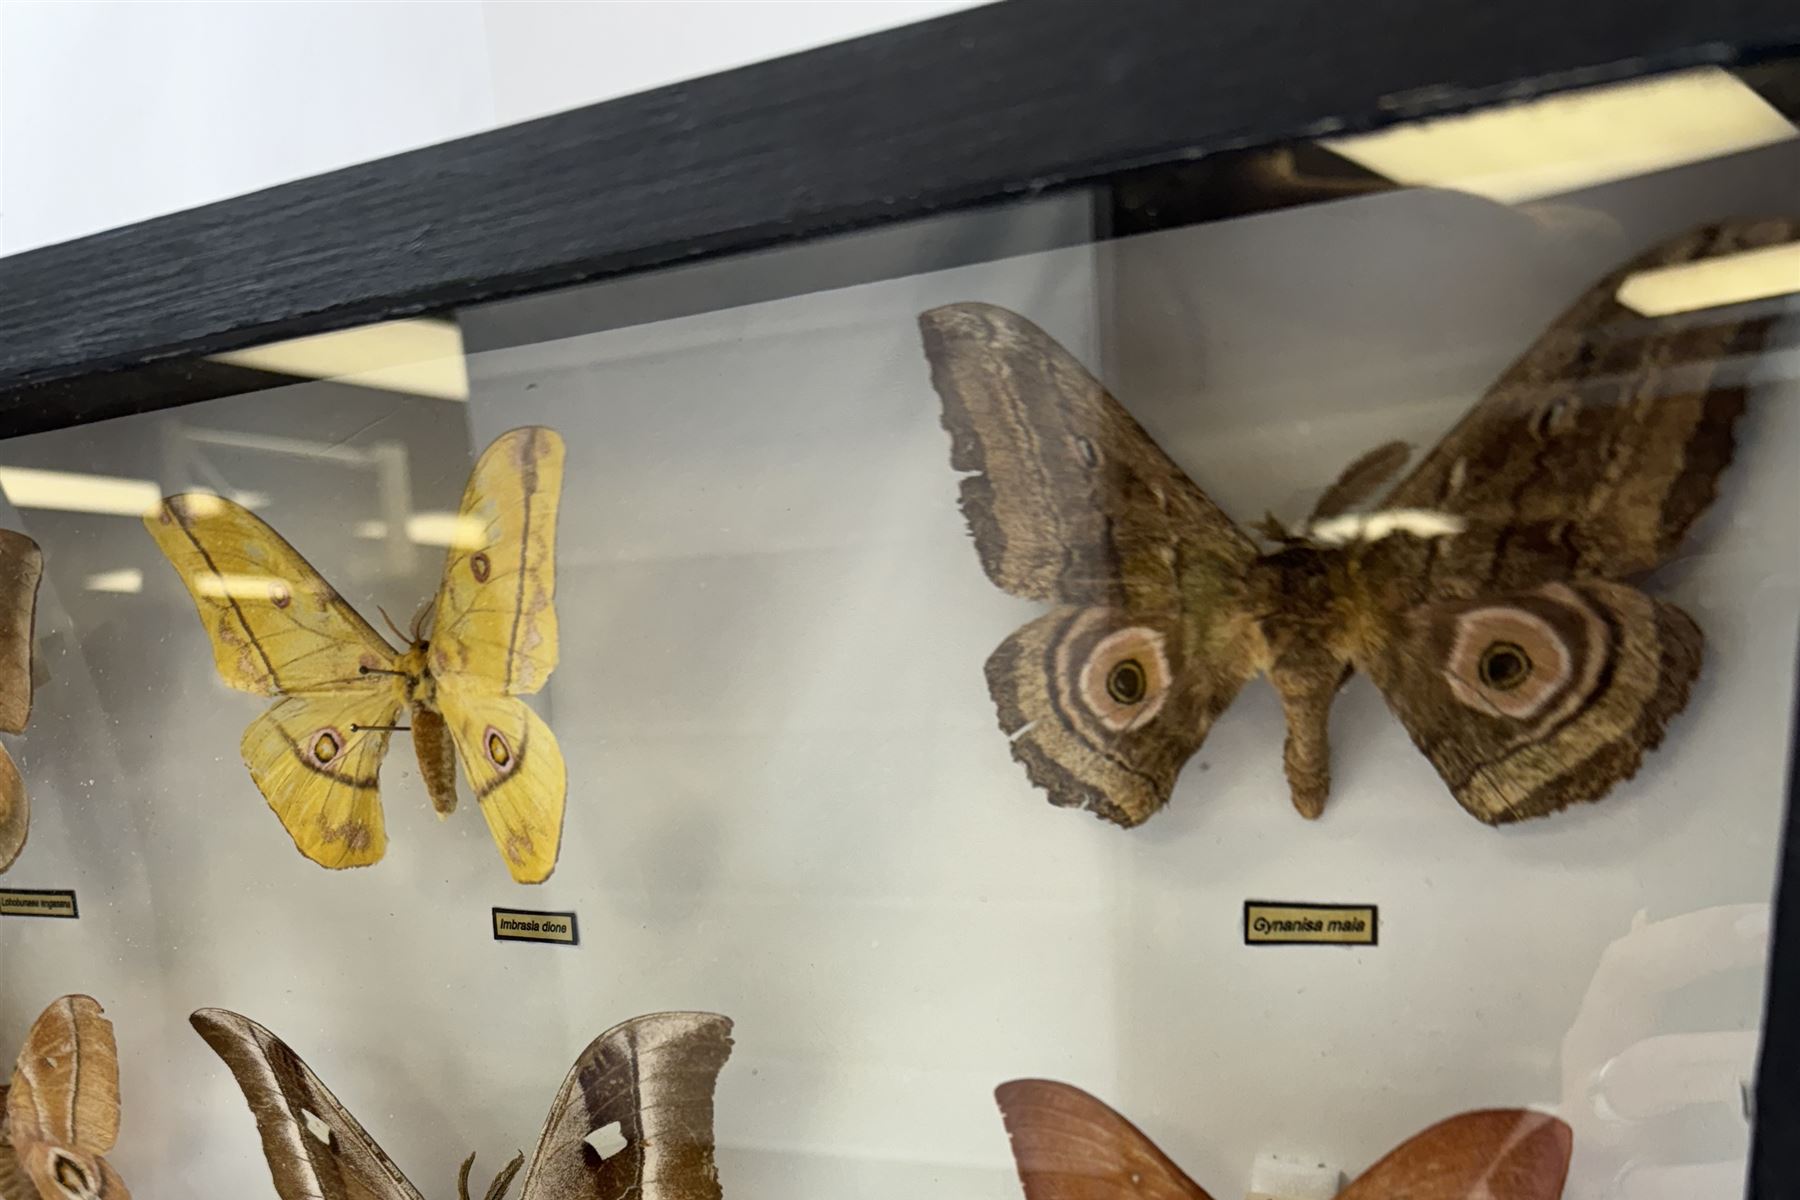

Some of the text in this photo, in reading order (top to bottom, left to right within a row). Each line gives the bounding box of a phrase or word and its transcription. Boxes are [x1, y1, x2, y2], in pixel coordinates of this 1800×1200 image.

[500, 919, 567, 933] Imbrasia dione
[1253, 917, 1323, 935] Gynanisa
